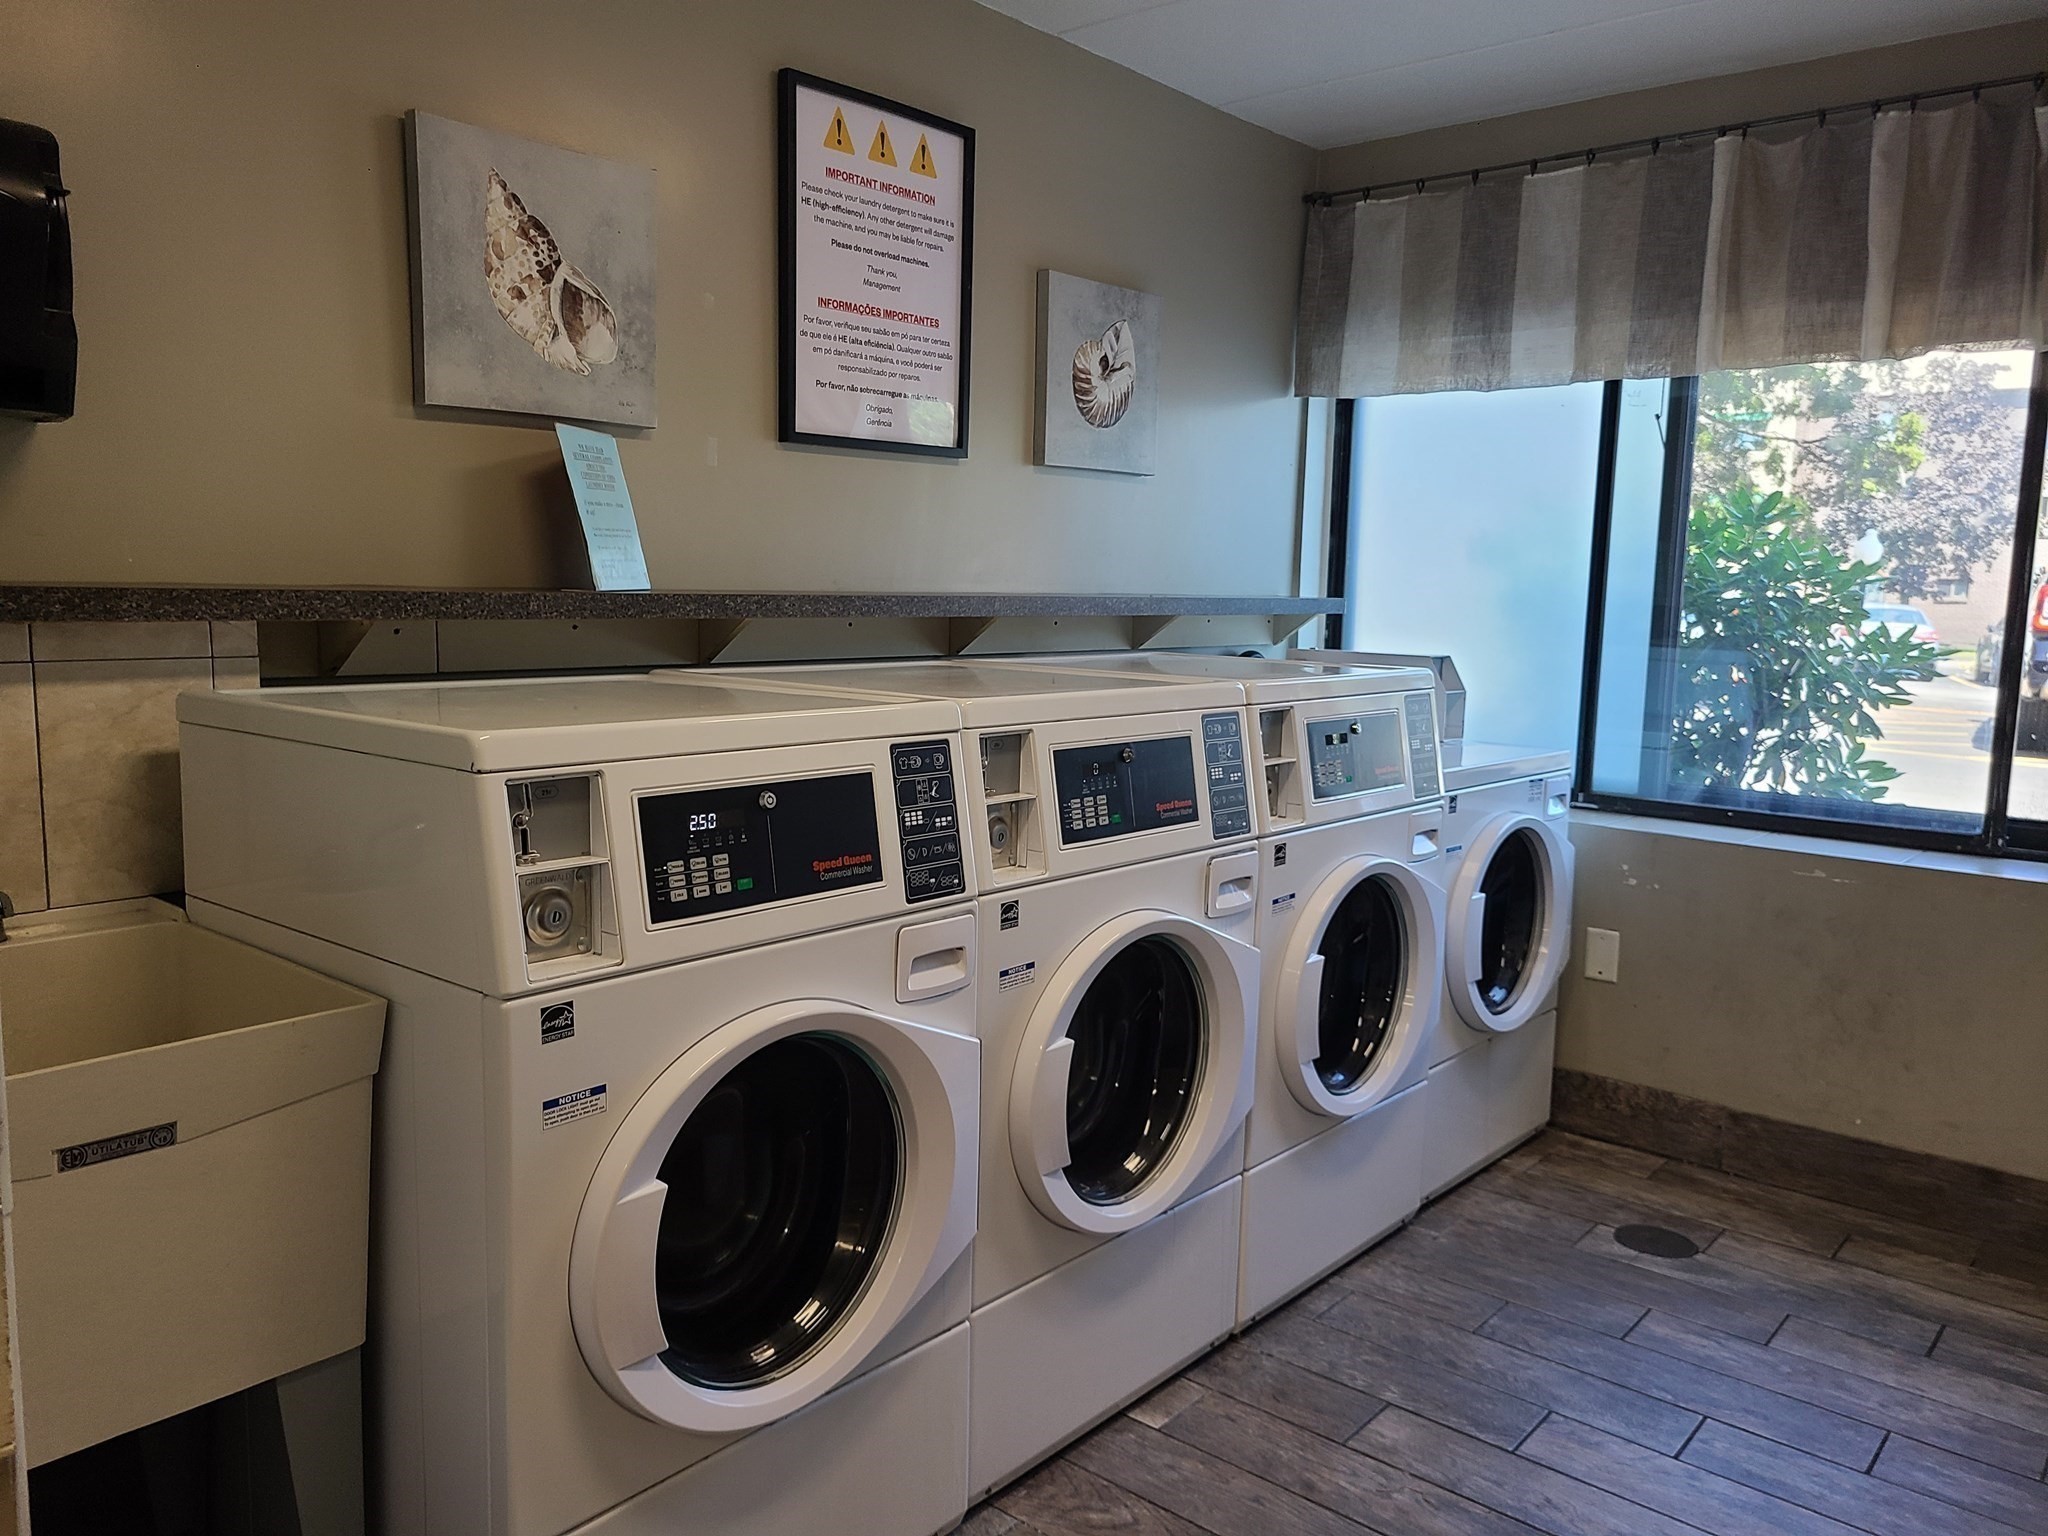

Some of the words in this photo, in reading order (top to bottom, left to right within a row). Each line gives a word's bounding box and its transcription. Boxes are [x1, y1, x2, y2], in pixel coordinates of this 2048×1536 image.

[826, 166, 878, 190] IMPORTANT
[880, 182, 936, 206] INFORMATION
[802, 181, 823, 194] Please
[824, 188, 843, 199] check
[844, 194, 858, 203] your
[859, 196, 882, 210] laundry
[882, 203, 910, 216] detergent
[911, 210, 917, 218] to
[918, 213, 932, 223] make
[933, 218, 945, 226] sure
[801, 196, 812, 206] HE
[813, 199, 866, 220] (high-efficiency).
[867, 213, 879, 224] Any
[880, 217, 896, 226] other
[896, 220, 923, 234] detergent
[924, 228, 933, 236] will
[933, 230, 955, 243] damage
[814, 215, 825, 224] the
[826, 218, 854, 232] machine,
[854, 225, 866, 234] and
[867, 228, 878, 236] you
[879, 230, 892, 241] may
[892, 232, 900, 241] be
[900, 235, 916, 245] liable
[916, 238, 924, 247] for
[924, 242, 944, 252] repairs.
[831, 238, 853, 251] Please
[853, 244, 862, 253] do
[863, 247, 873, 256] not
[874, 250, 900, 261] overload
[901, 256, 930, 268] machines.
[867, 265, 885, 276] Thank
[886, 271, 898, 280] you,
[863, 278, 901, 293] Management
[818, 297, 882, 318] INFORMAÇÕES
[883, 309, 940, 328] IMPORTANTES
[804, 314, 815, 324] Por
[816, 317, 833, 328] favor,
[834, 322, 860, 332] verifique
[861, 326, 872, 334] seu
[873, 328, 891, 337] sabão
[901, 332, 909, 340] pó
[931, 338, 951, 348] certeza
[800, 329, 809, 337] de
[809, 331, 822, 340] que
[823, 333, 832, 341] ele
[838, 335, 848, 344] HE
[849, 336, 863, 346] (alta
[897, 344, 922, 355] Qualquer
[922, 350, 937, 359] outro
[937, 352, 954, 361] sabão
[833, 348, 863, 360] danificará
[869, 354, 895, 365] máquina,
[914, 362, 933, 371] poderá
[838, 364, 888, 377] responsabilizado
[888, 371, 898, 379] por
[899, 373, 921, 382] reparos.
[816, 379, 828, 389] Por
[829, 381, 846, 392] favor,
[847, 385, 859, 393] não
[860, 387, 903, 399] sobrecarregue
[866, 403, 894, 415] Obrigado,
[867, 418, 892, 428] Gerência
[1155, 801, 1174, 813] Speed
[1175, 799, 1192, 808] Queen
[690, 813, 717, 831] 2.50
[813, 857, 843, 872] Speed
[844, 854, 872, 866] Queen
[820, 868, 853, 881] Commercial
[853, 865, 873, 875] Washer
[559, 1090, 591, 1105] NOTICE
